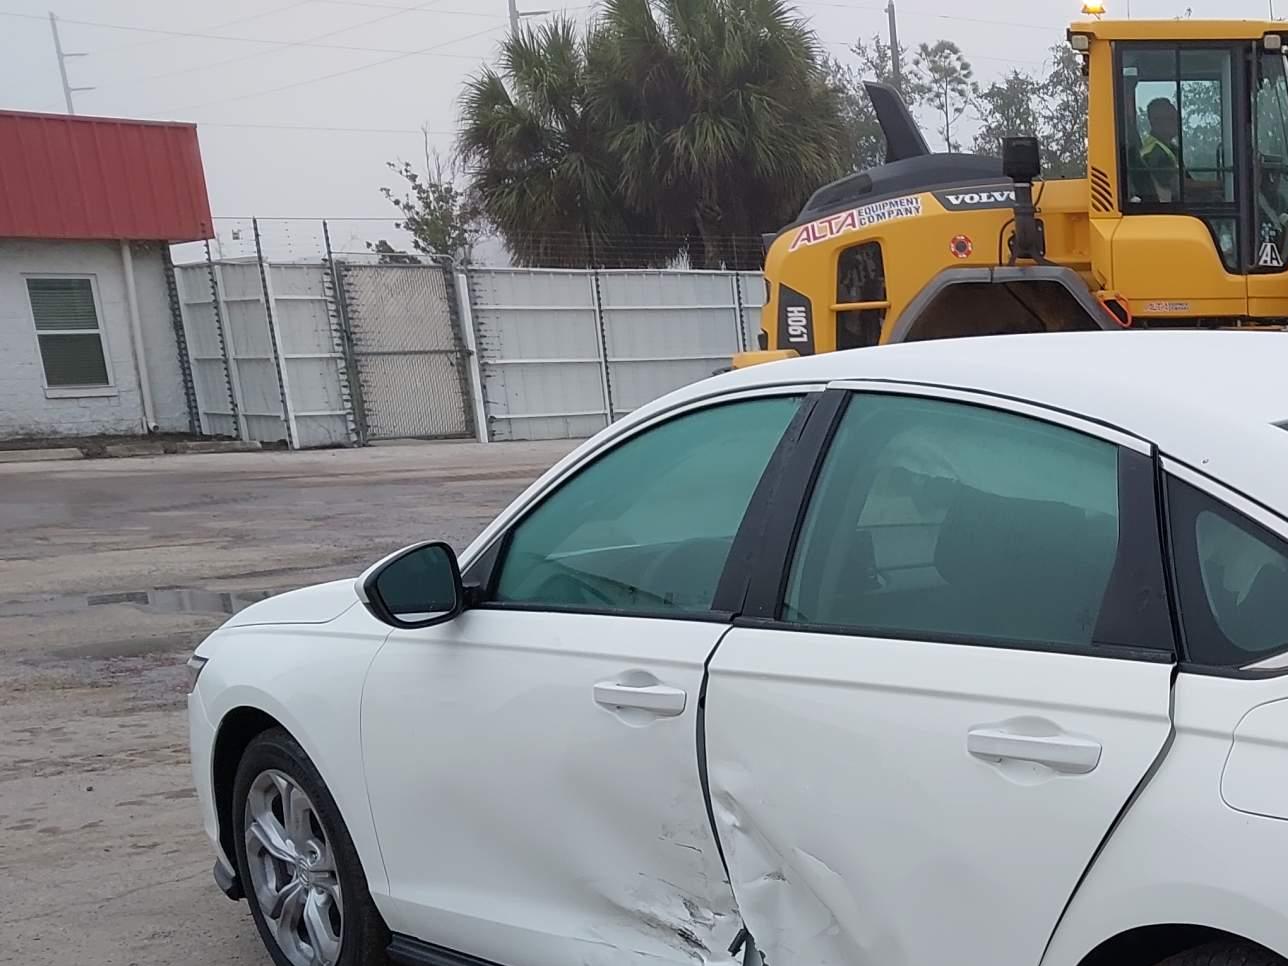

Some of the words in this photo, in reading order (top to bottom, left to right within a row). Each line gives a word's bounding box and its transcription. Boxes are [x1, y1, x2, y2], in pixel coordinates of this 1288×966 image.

[858, 197, 921, 217] EQUIPMENT
[860, 206, 921, 226] COMPANY
[790, 211, 858, 251] ALTA
[786, 306, 808, 342] L90H
